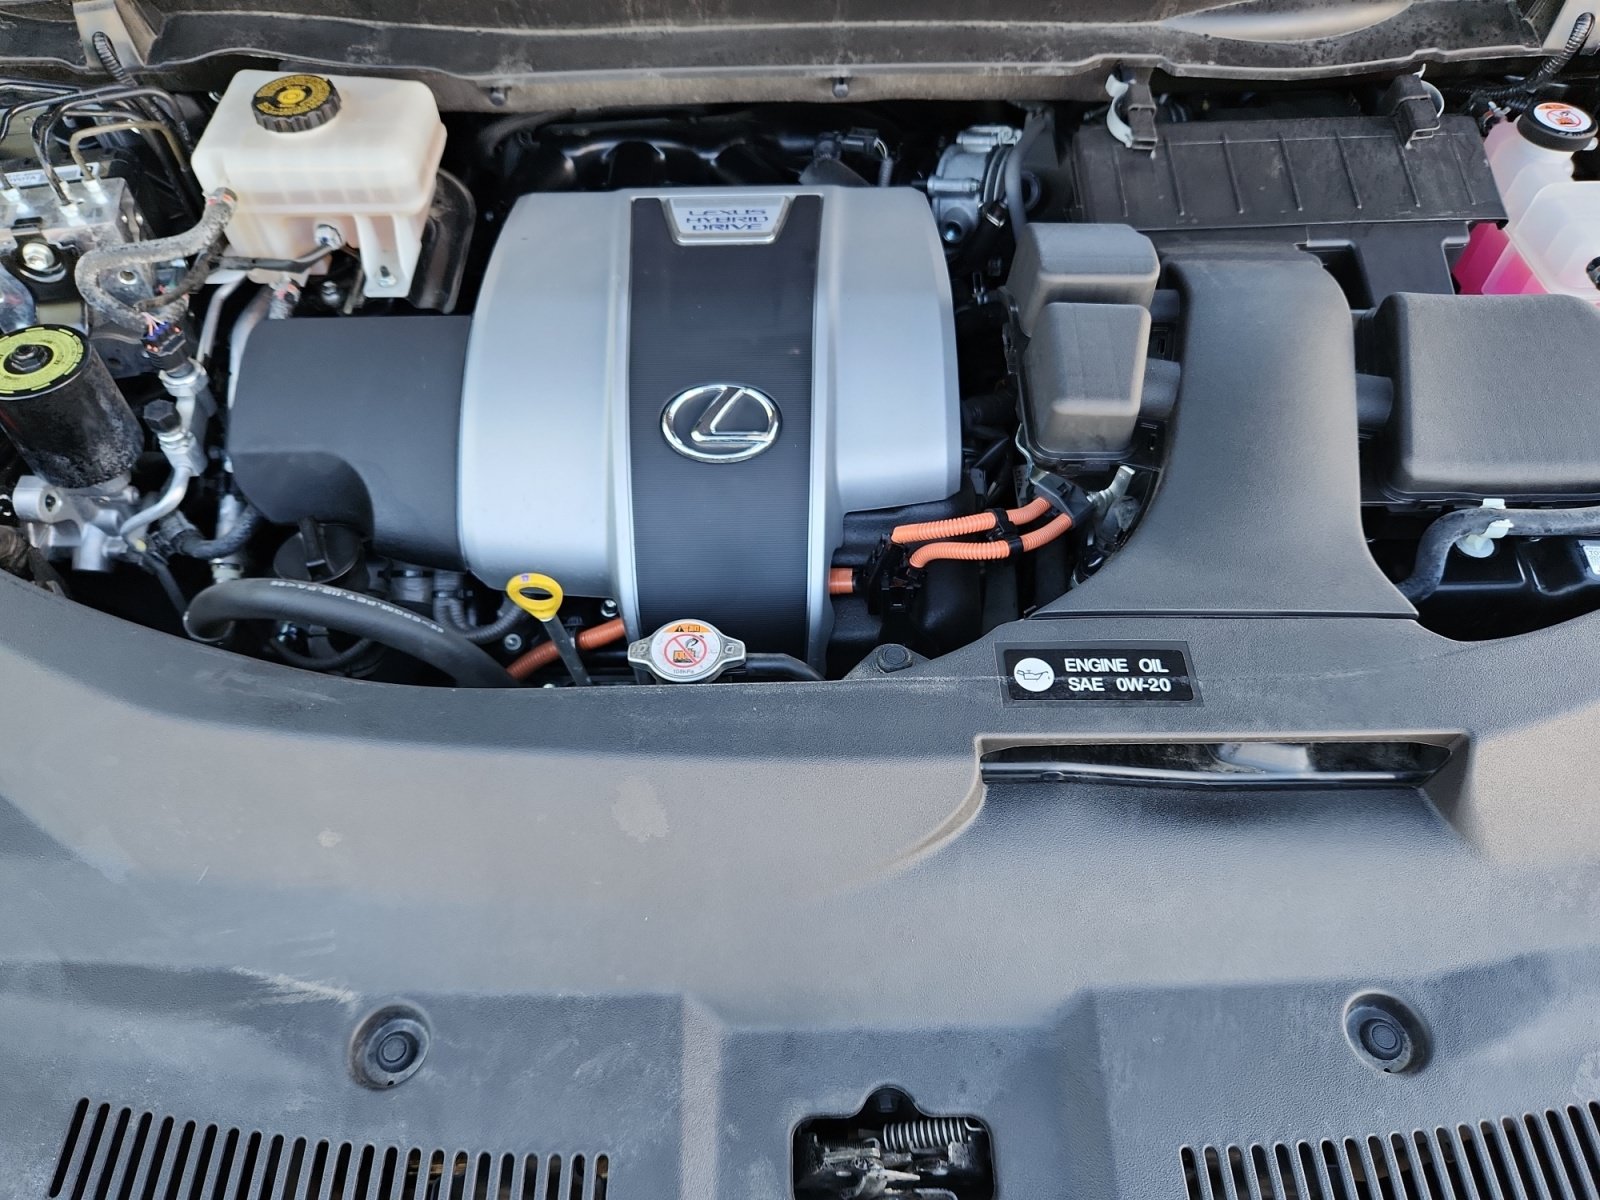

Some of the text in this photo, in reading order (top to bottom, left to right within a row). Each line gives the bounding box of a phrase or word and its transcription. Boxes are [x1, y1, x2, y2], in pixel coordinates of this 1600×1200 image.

[1064, 658, 1169, 673] ENGINE OIL
[1068, 677, 1172, 692] SAE 0W-20
